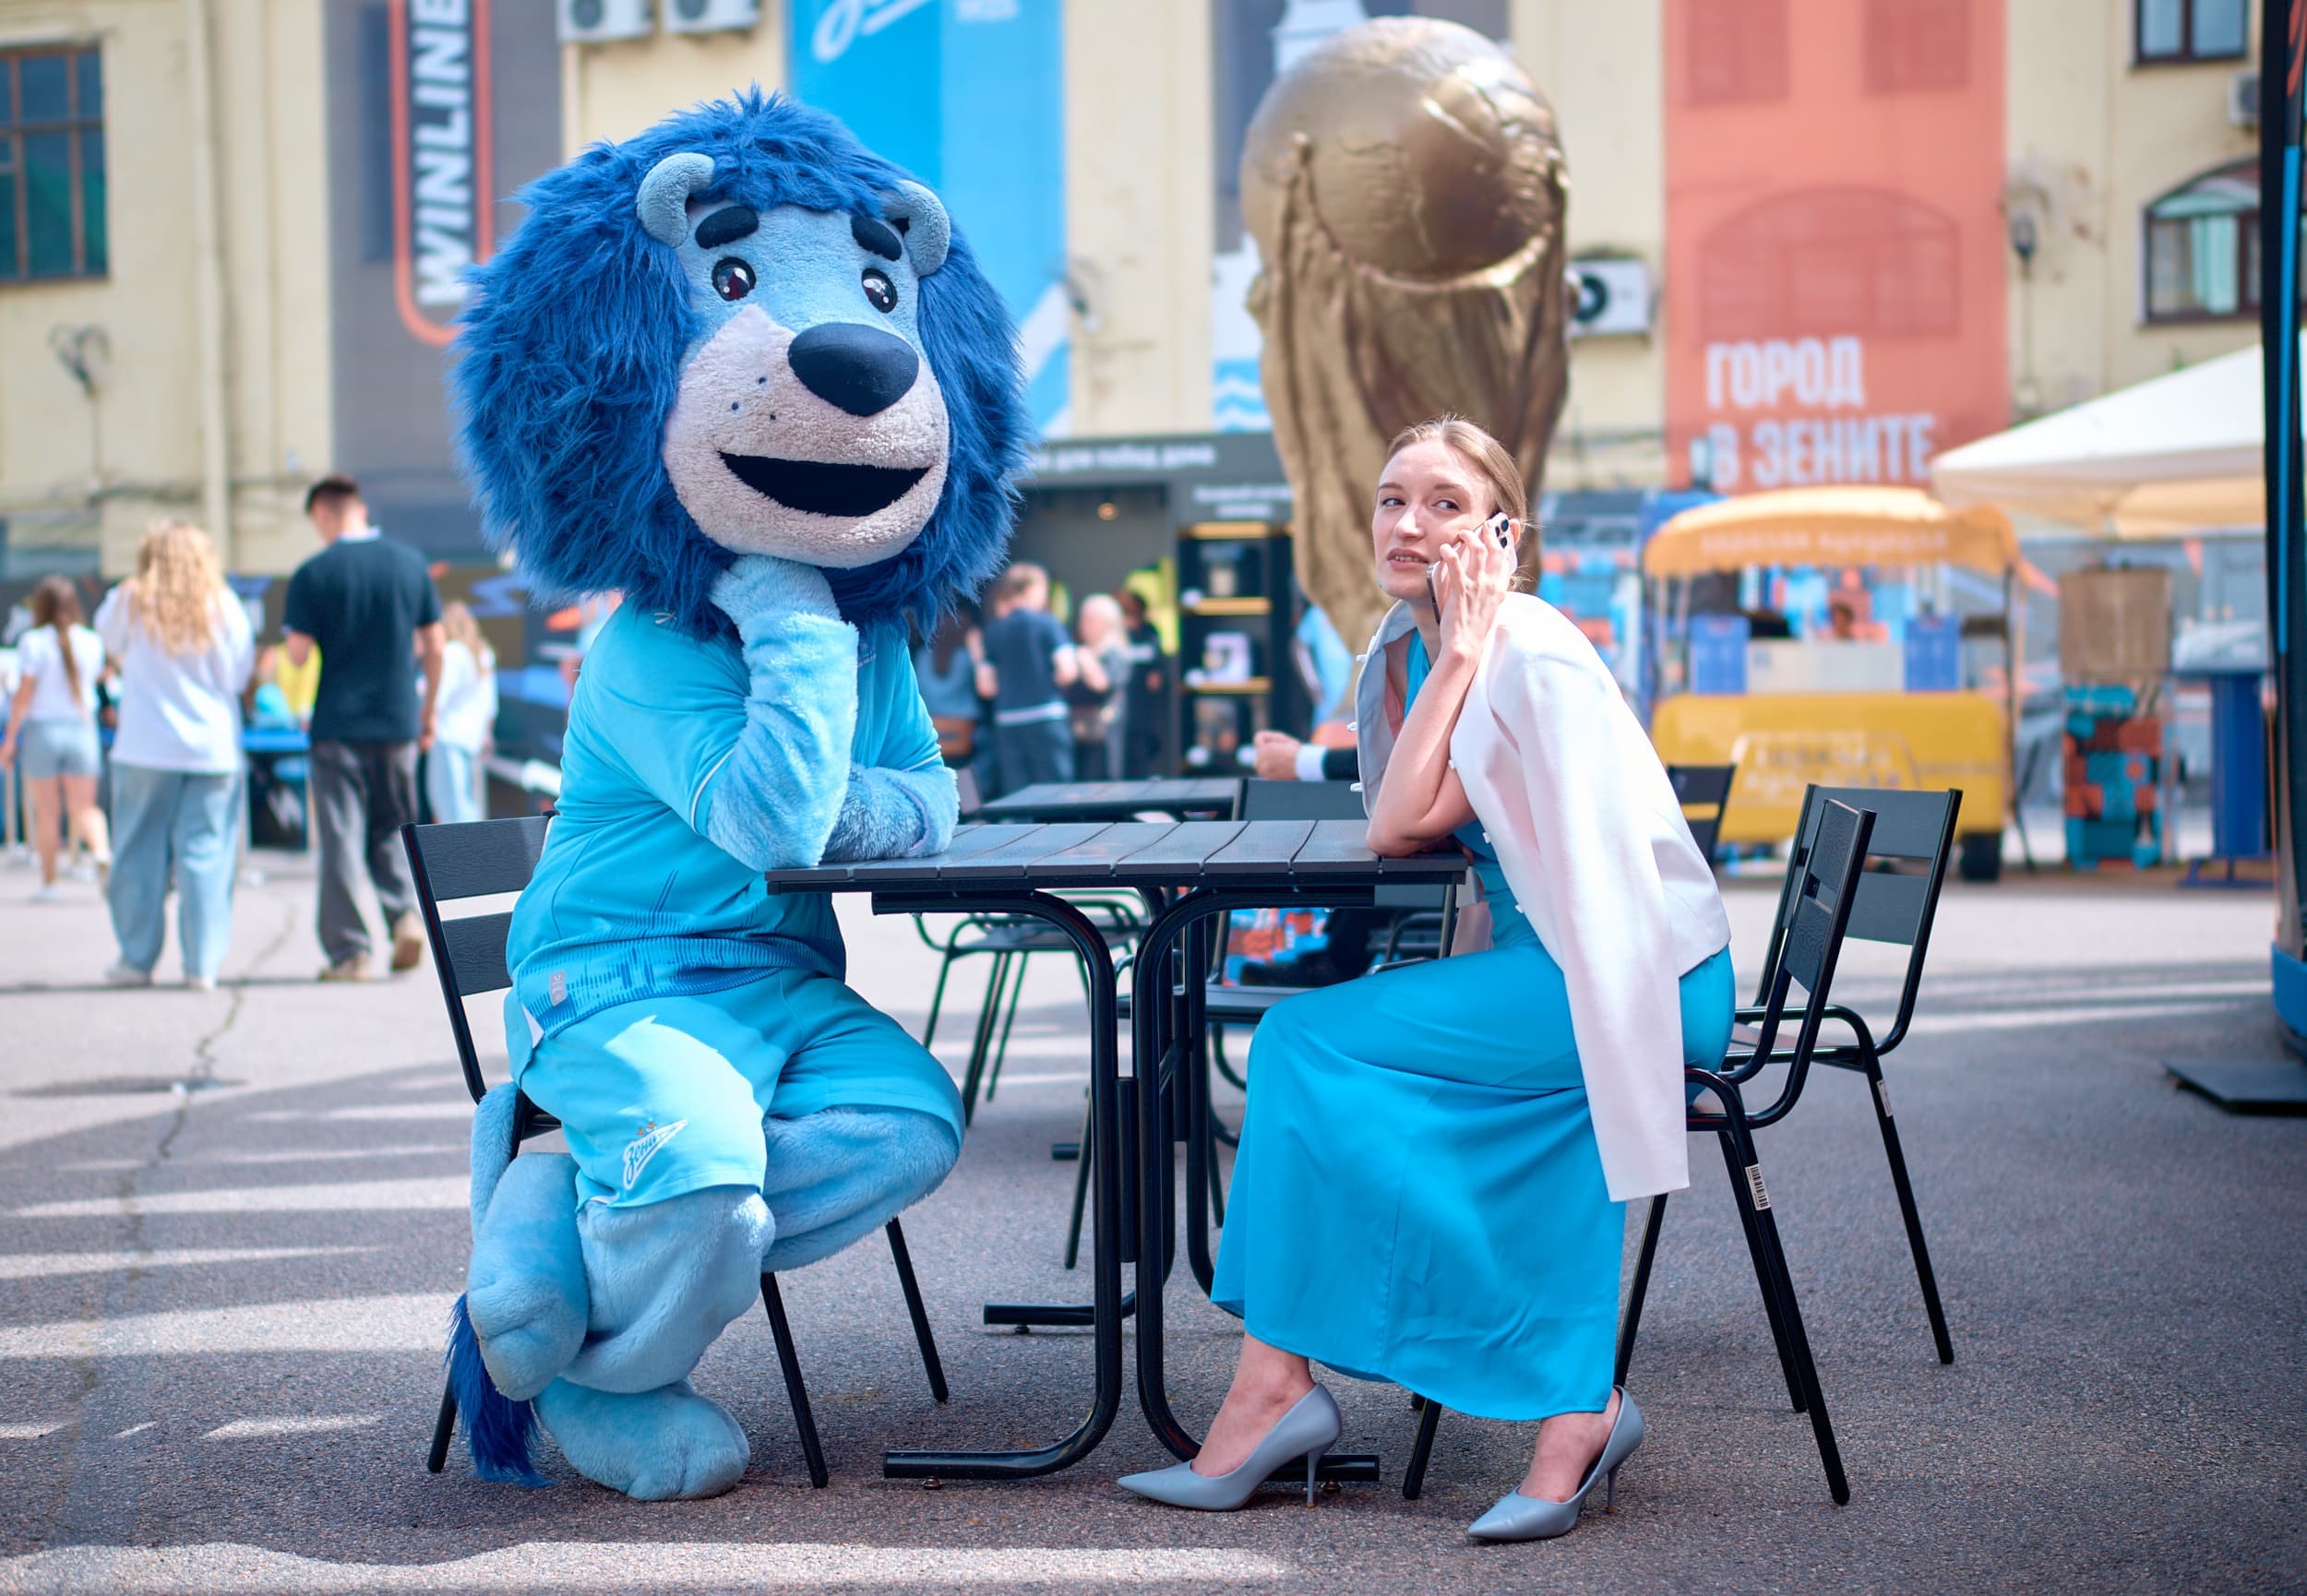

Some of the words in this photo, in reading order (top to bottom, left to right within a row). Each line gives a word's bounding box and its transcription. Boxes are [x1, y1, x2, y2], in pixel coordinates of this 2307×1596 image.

[412, 0, 472, 304] WINLINE
[1706, 336, 1865, 409] ГОРОД
[1709, 423, 1740, 487] В
[1753, 413, 1934, 486] ЗЕНИТЕ
